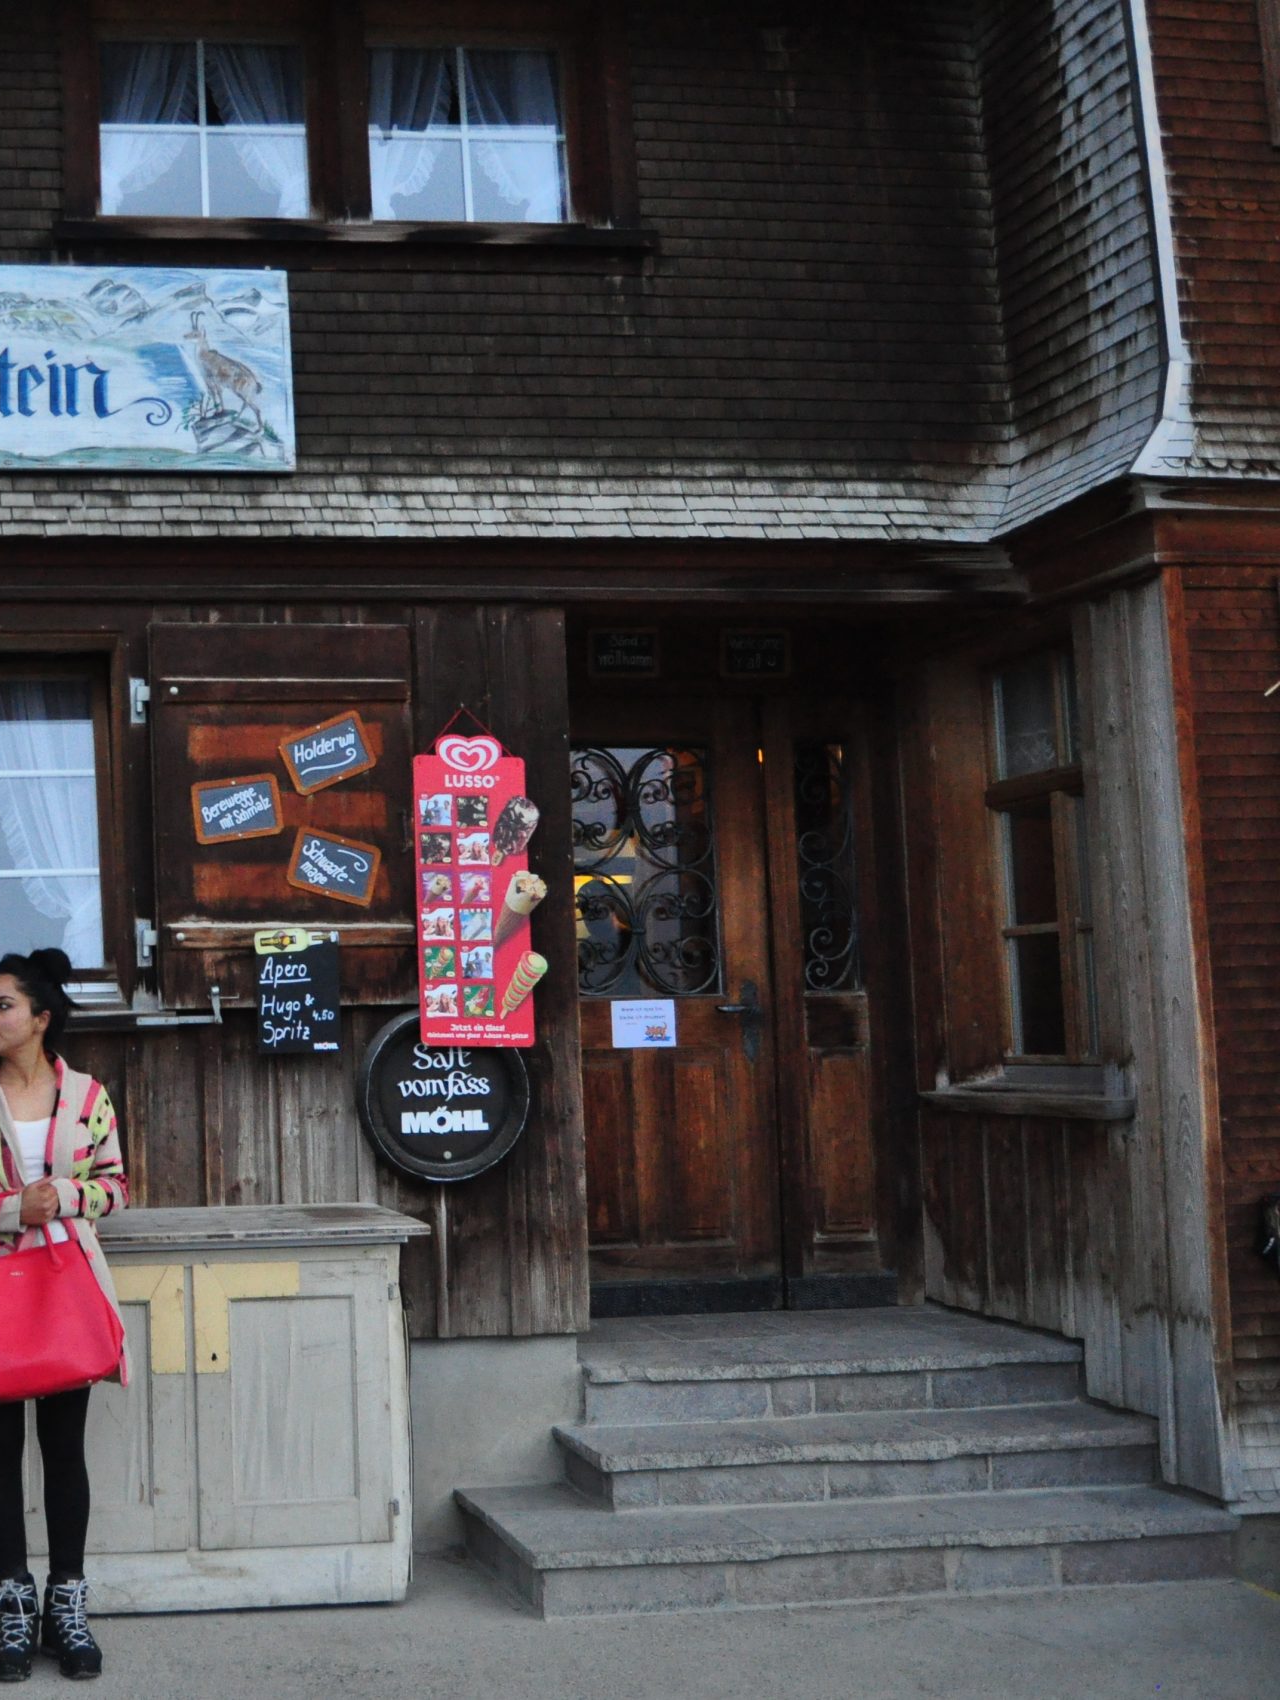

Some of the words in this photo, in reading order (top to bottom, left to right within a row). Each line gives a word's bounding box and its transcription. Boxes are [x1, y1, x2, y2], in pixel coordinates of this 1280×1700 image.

[444, 774, 495, 789] LUSSO
[232, 795, 272, 825] Schmalz
[300, 860, 328, 885] mage
[261, 994, 301, 1021] Hugo
[304, 993, 315, 1007] &
[312, 1009, 335, 1021] 4.50
[263, 1020, 311, 1048] Spritz
[401, 1106, 489, 1134] MÖHL
